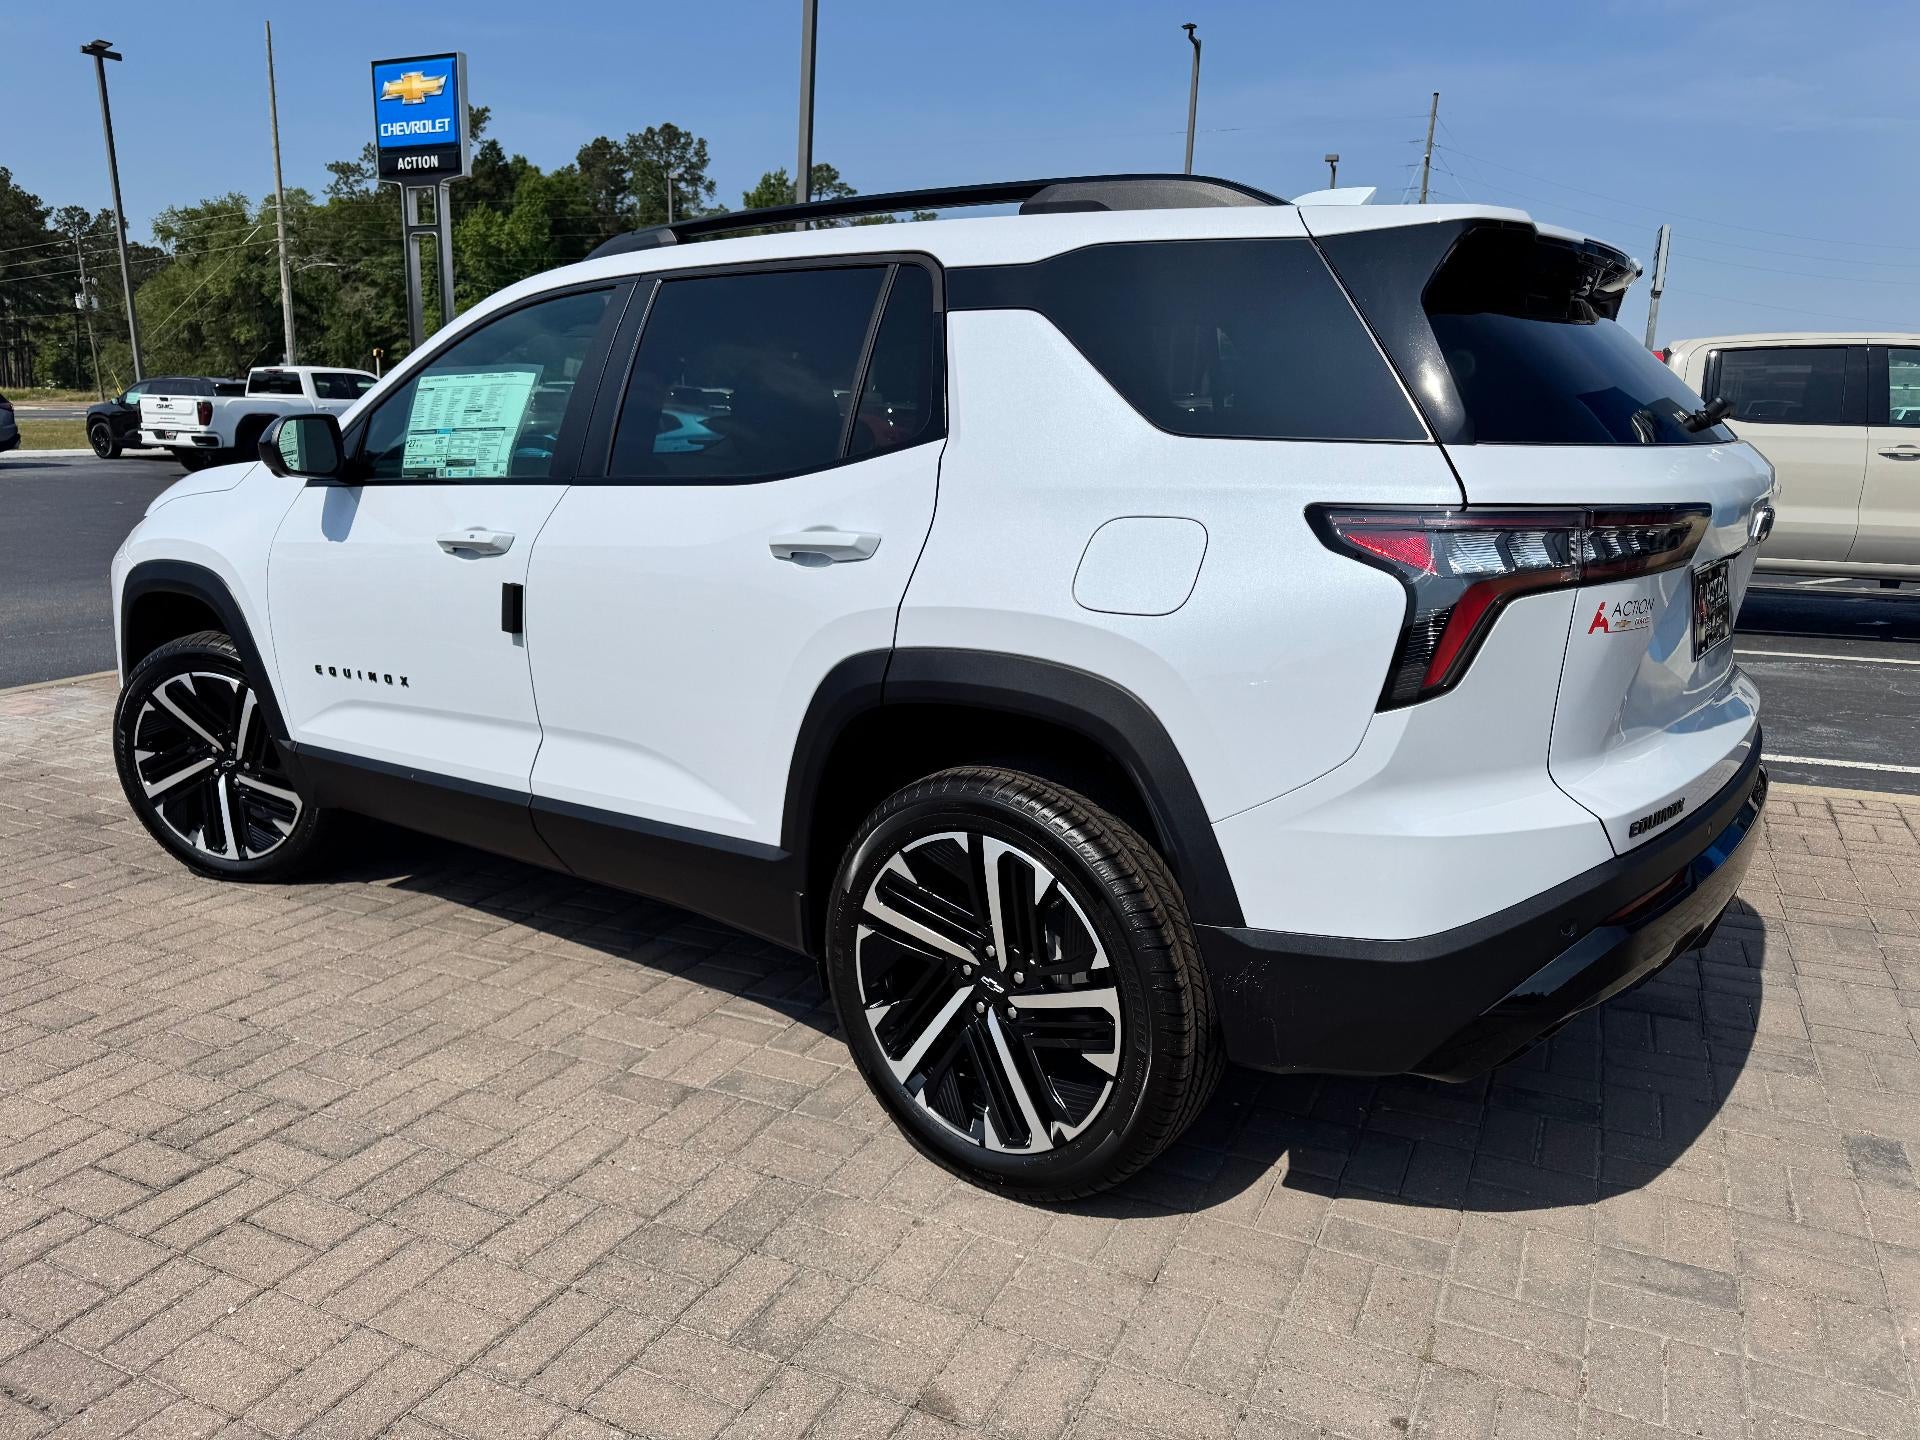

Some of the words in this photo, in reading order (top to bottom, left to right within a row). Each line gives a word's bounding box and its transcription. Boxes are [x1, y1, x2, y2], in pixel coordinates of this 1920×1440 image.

[380, 118, 451, 137] CHEVROLET
[397, 154, 439, 171] ACTION
[1611, 598, 1655, 618] ACTION
[314, 664, 410, 689] EQUINOX
